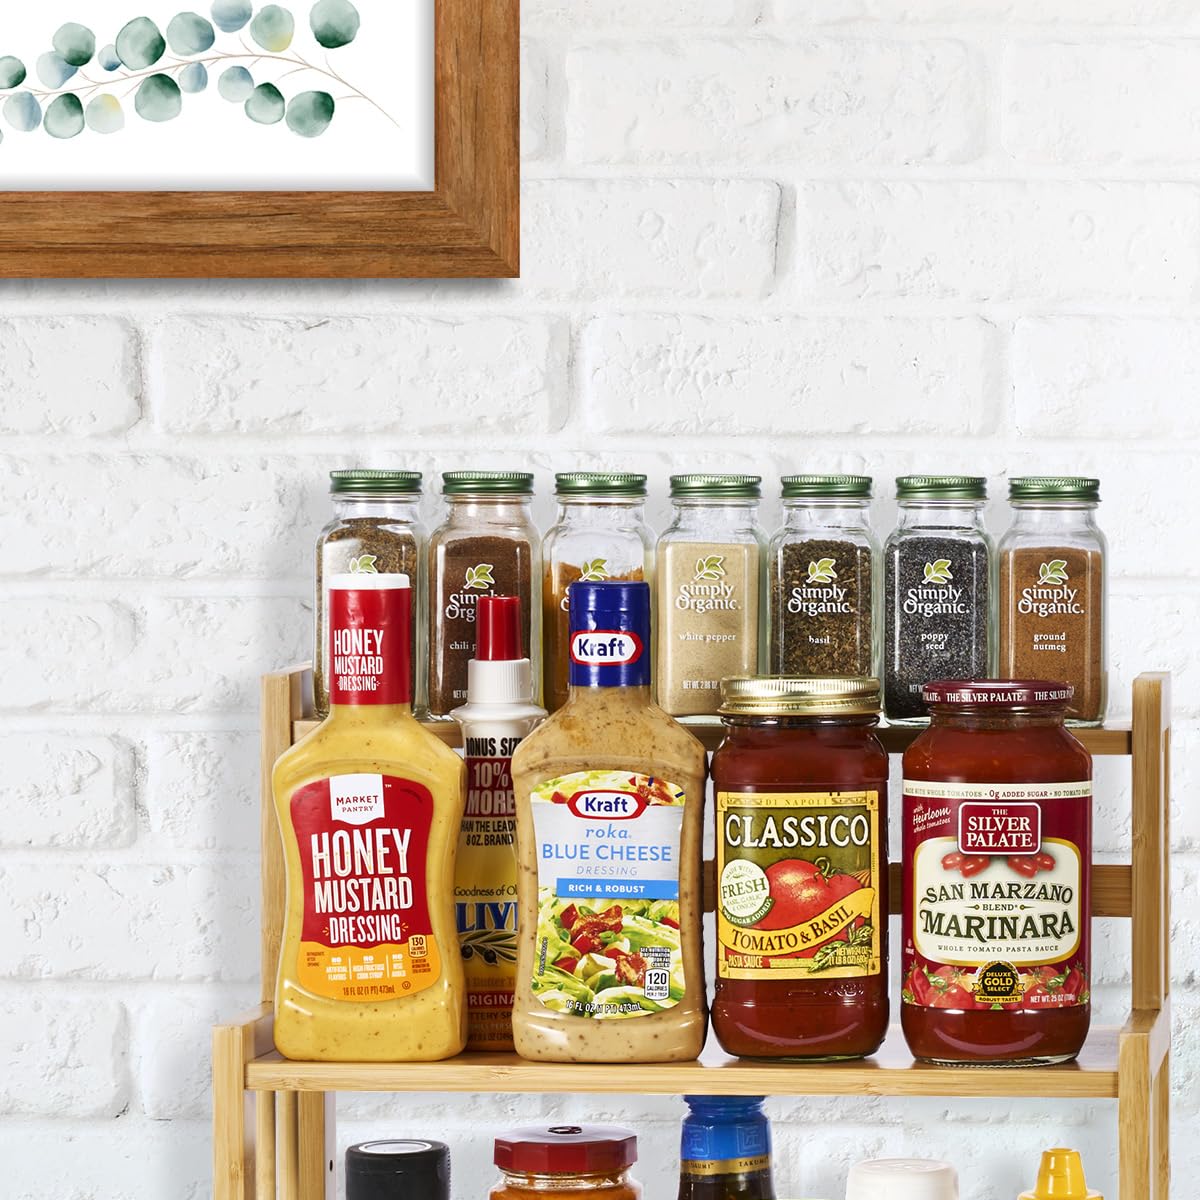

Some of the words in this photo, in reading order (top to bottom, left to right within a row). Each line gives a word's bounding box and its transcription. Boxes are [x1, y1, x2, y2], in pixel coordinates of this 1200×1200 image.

[679, 581, 736, 602] Simply
[792, 584, 847, 602] Simply
[907, 585, 962, 603] Simply
[1022, 585, 1078, 603] Simply
[334, 628, 384, 655] HONEY
[679, 632, 704, 642] white
[706, 633, 737, 644] pepper
[808, 635, 830, 644] basil
[920, 632, 949, 643] poppy
[1033, 632, 1066, 643] ground
[449, 641, 469, 650] chili
[578, 637, 625, 657] Kraft
[925, 642, 945, 650] seed
[1033, 643, 1067, 652] nutmeg
[334, 656, 384, 675] MUSTARD
[338, 675, 377, 691] DRESSING
[946, 692, 961, 703] THE
[961, 693, 988, 703] SILVER
[990, 692, 1023, 703] PALATE
[1034, 690, 1048, 701] THE
[473, 761, 509, 788] 10%
[336, 794, 379, 806] MARKET
[989, 789, 1000, 800] 0g
[1002, 790, 1027, 798] ADDED
[1027, 790, 1048, 798] SUGAR
[342, 805, 374, 813] PANTRY
[466, 789, 516, 815] MORE
[585, 796, 628, 813] Kraft
[786, 798, 828, 806] NAPOLI
[912, 806, 952, 826] Heirloom
[926, 817, 951, 829] tomatoes
[460, 820, 474, 832] HAN
[475, 820, 490, 833] THE
[725, 813, 869, 848] CLASSICO
[968, 816, 1031, 832] SILVER
[585, 824, 629, 839] roka
[484, 833, 514, 846] BRAND
[966, 832, 1033, 848] PALATE
[311, 828, 412, 879] HONEY
[542, 843, 590, 860] BLUE
[595, 844, 672, 862] CHEESE
[576, 865, 638, 876] DRESSING
[313, 876, 413, 914] MUSTARD
[454, 884, 494, 897] Goodness
[496, 884, 505, 896] of
[568, 884, 592, 893] RICH
[595, 884, 602, 893] &
[605, 885, 645, 893] ROBUST
[721, 877, 767, 899] FRESH
[920, 883, 964, 905] SAN
[970, 882, 1073, 904] MARZANO
[328, 914, 402, 944] DRESSING
[731, 928, 798, 952] TOMATO
[800, 931, 811, 944] &
[809, 905, 854, 940] BASIL
[919, 909, 1075, 943] MARINARA
[411, 936, 424, 946] 130
[937, 944, 964, 952] WHOLE
[728, 954, 743, 968] PASTA
[743, 955, 763, 968] SAUCE
[648, 972, 667, 985] 120
[983, 977, 1013, 986] GOLD
[566, 1000, 574, 1009] 16
[575, 1001, 583, 1010] FL
[585, 1003, 594, 1012] OZ
[619, 1002, 643, 1013] 473mL
